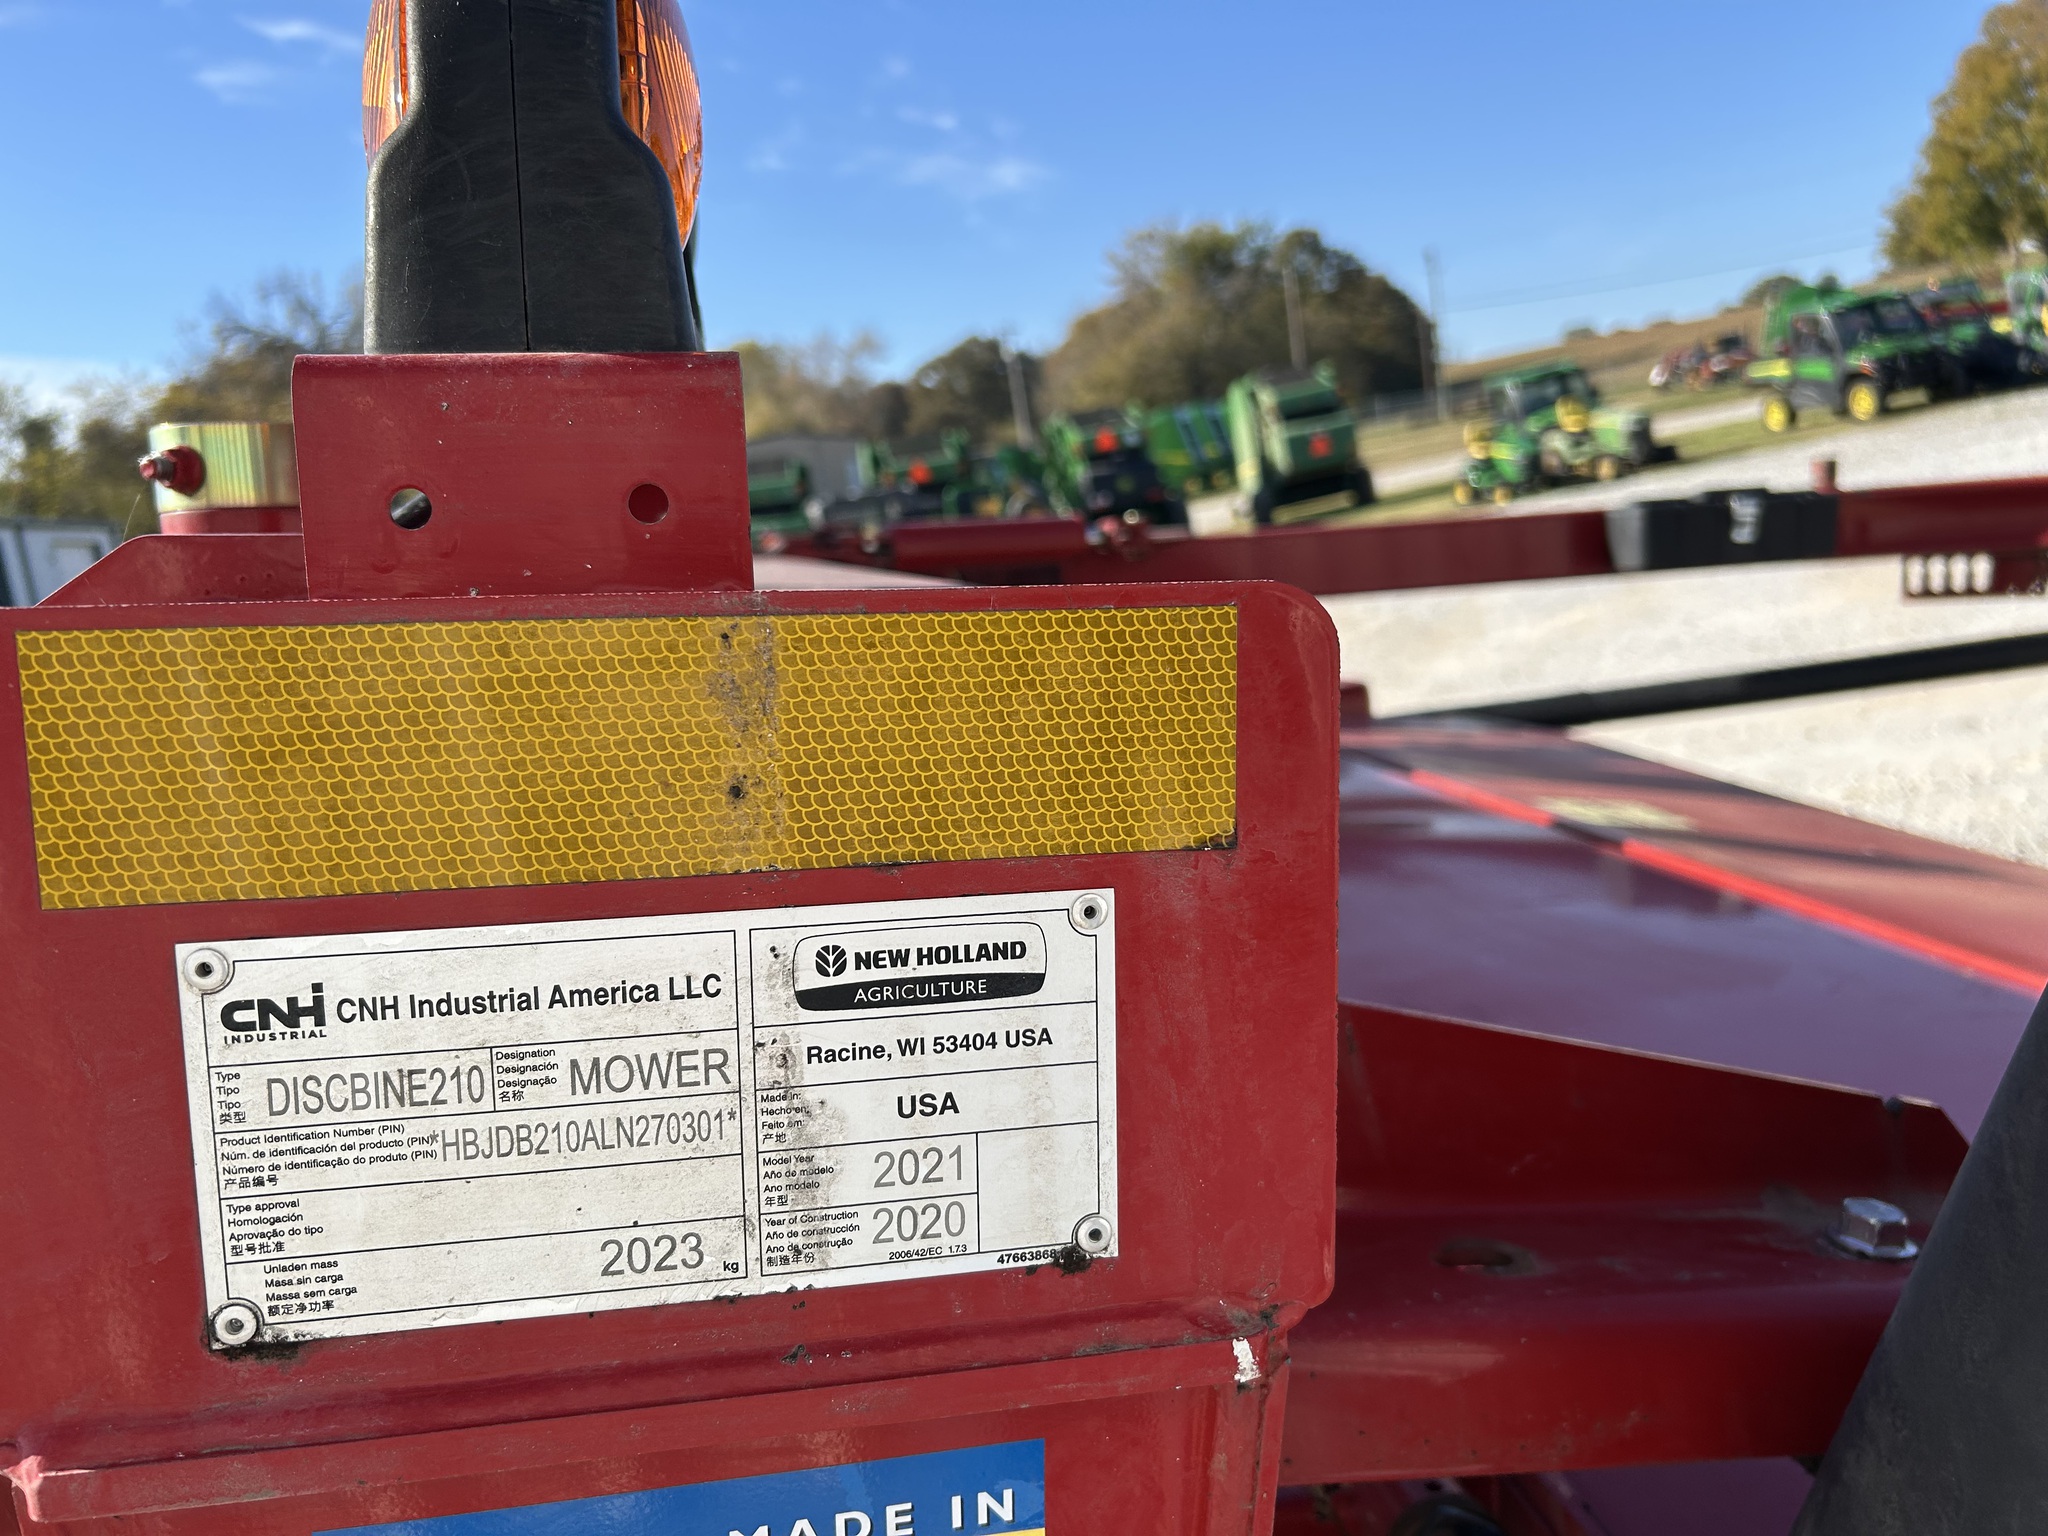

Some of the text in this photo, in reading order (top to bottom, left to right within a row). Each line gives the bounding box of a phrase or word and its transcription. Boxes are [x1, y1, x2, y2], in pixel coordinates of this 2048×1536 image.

[854, 940, 1027, 970] NEW HOLLAND
[336, 973, 722, 1023] CNH Industrial America LLC
[854, 979, 988, 1003] AGRICULTURE
[224, 1029, 327, 1045] INDUSTRIAL
[806, 1028, 1053, 1065] Racine, WI 53404 USA
[495, 1048, 556, 1061] Designation
[496, 1061, 559, 1075] Designación
[569, 1048, 732, 1096] MOWER
[215, 1071, 241, 1082] Type
[497, 1075, 558, 1089] Designação
[216, 1085, 240, 1097] Tipo
[266, 1065, 485, 1117] DISCBINE210
[498, 1090, 525, 1103] 名称
[760, 1093, 787, 1103] Made
[217, 1100, 241, 1112] Tipo
[761, 1106, 792, 1116] Hecho
[896, 1091, 960, 1119] USA
[219, 1112, 247, 1124] 类型
[762, 1120, 785, 1130] Feito
[220, 1124, 405, 1147] Product Identification Number (PIN)
[762, 1132, 787, 1144] 产地
[221, 1135, 434, 1161] Núm. de identificación del producto (PIN)
[223, 1149, 438, 1175] Número de identificação do produto (PIN)
[763, 1154, 815, 1166] Model Year
[873, 1144, 962, 1189] 2021
[763, 1165, 835, 1180] Año de modelo
[224, 1175, 279, 1189] 产品编号
[764, 1180, 820, 1193] Ano modelo
[226, 1199, 300, 1216] Type approval
[765, 1194, 789, 1207] 年型
[228, 1213, 304, 1228] Homologación
[765, 1211, 859, 1227] Year of Construction
[872, 1200, 966, 1245] 2020
[229, 1225, 324, 1242] Aprovação do tipo
[765, 1223, 860, 1240] Año de construcción
[766, 1238, 853, 1254] Ano de construção
[889, 1246, 943, 1260] 2006/42/EC
[600, 1232, 739, 1277] 2023 kg
[997, 1248, 1057, 1265] 47663868
[264, 1260, 339, 1274] Unladen mass
[265, 1274, 344, 1288] Masa sin carga
[266, 1287, 358, 1302] Massa sem carga
[728, 1488, 1014, 1536] ADE IN
